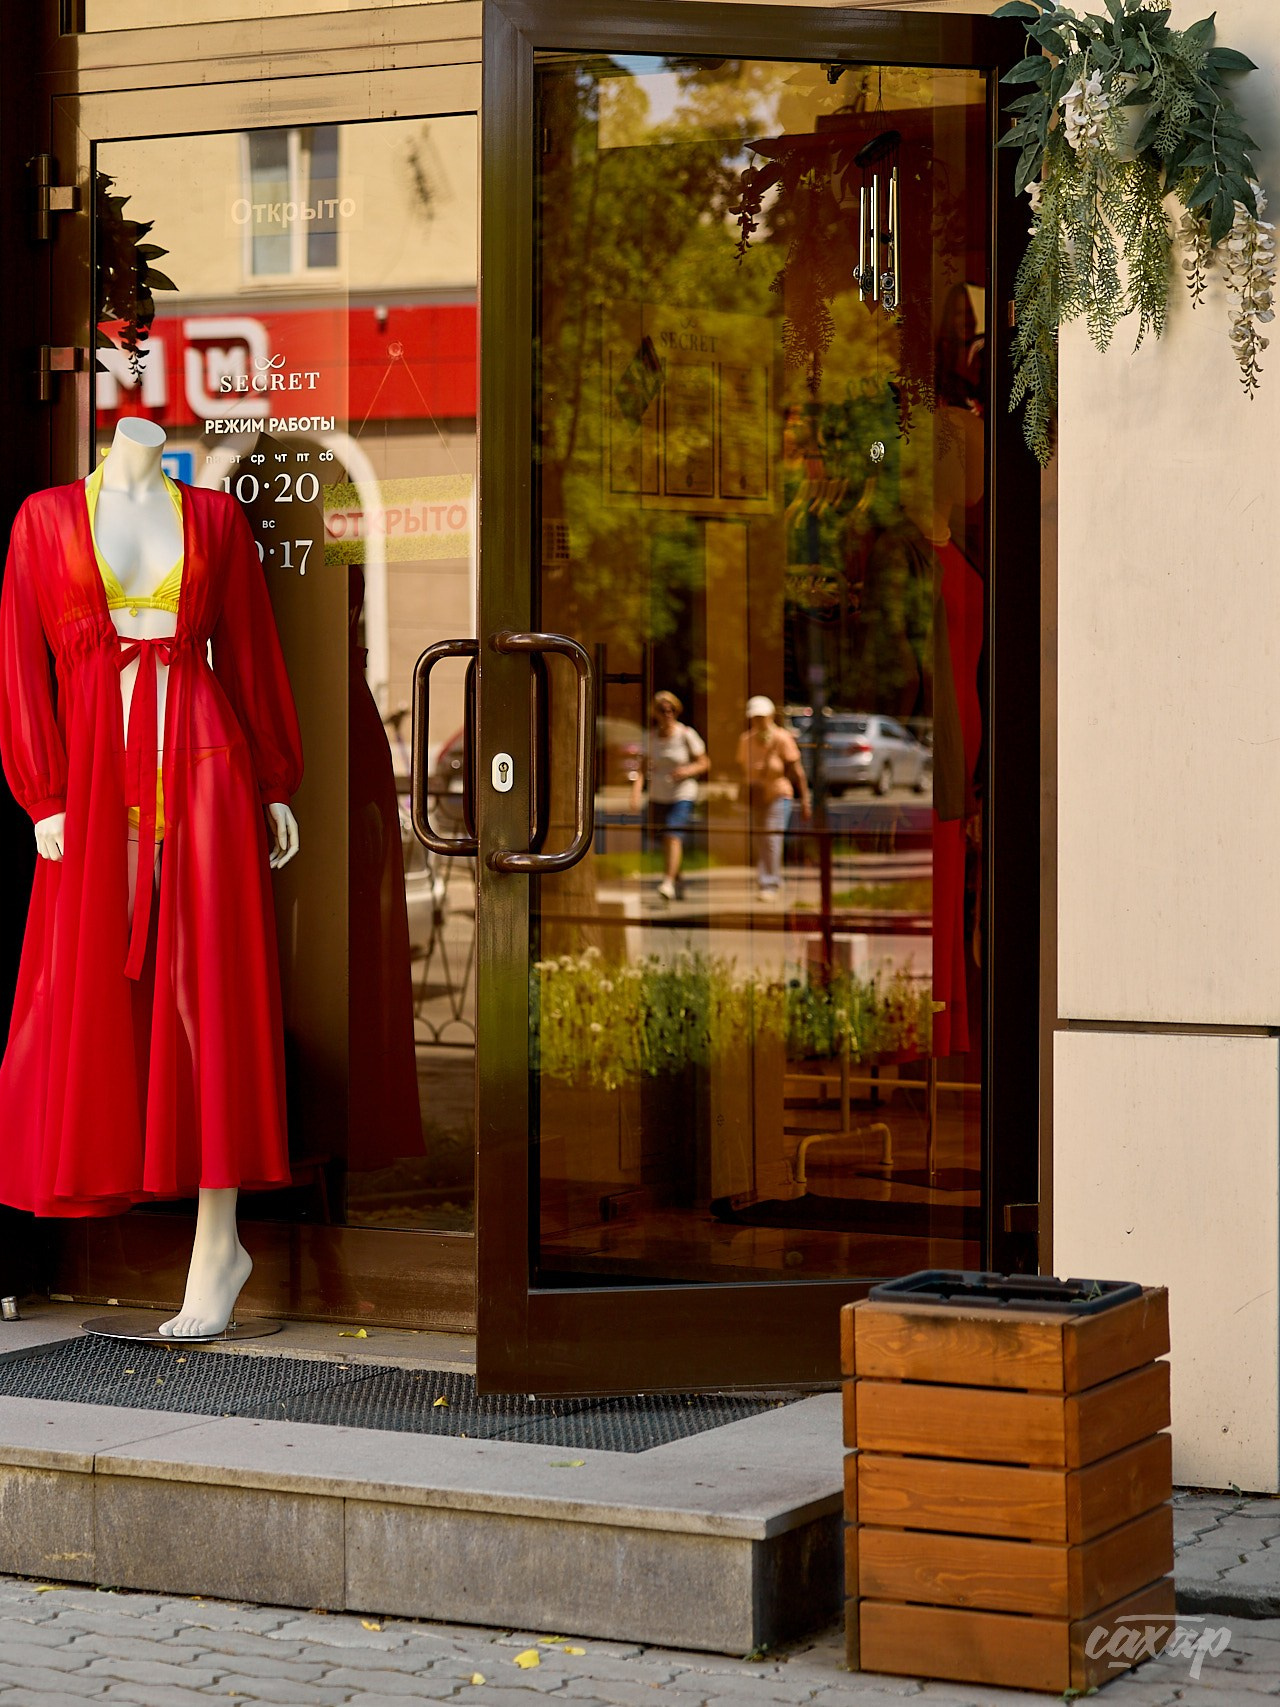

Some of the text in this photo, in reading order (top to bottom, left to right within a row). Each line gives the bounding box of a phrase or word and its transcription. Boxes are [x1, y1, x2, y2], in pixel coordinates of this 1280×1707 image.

[230, 198, 356, 229] Открыто
[660, 331, 719, 353] SECRET
[219, 372, 320, 393] SECRET
[205, 416, 335, 434] РЕЖИМ РАБОТЫ
[229, 454, 241, 464] вт
[250, 454, 265, 465] ср
[274, 453, 288, 463] чт
[296, 452, 310, 462] пт
[318, 450, 334, 462] сб
[327, 504, 467, 539] ОТКРЫТО
